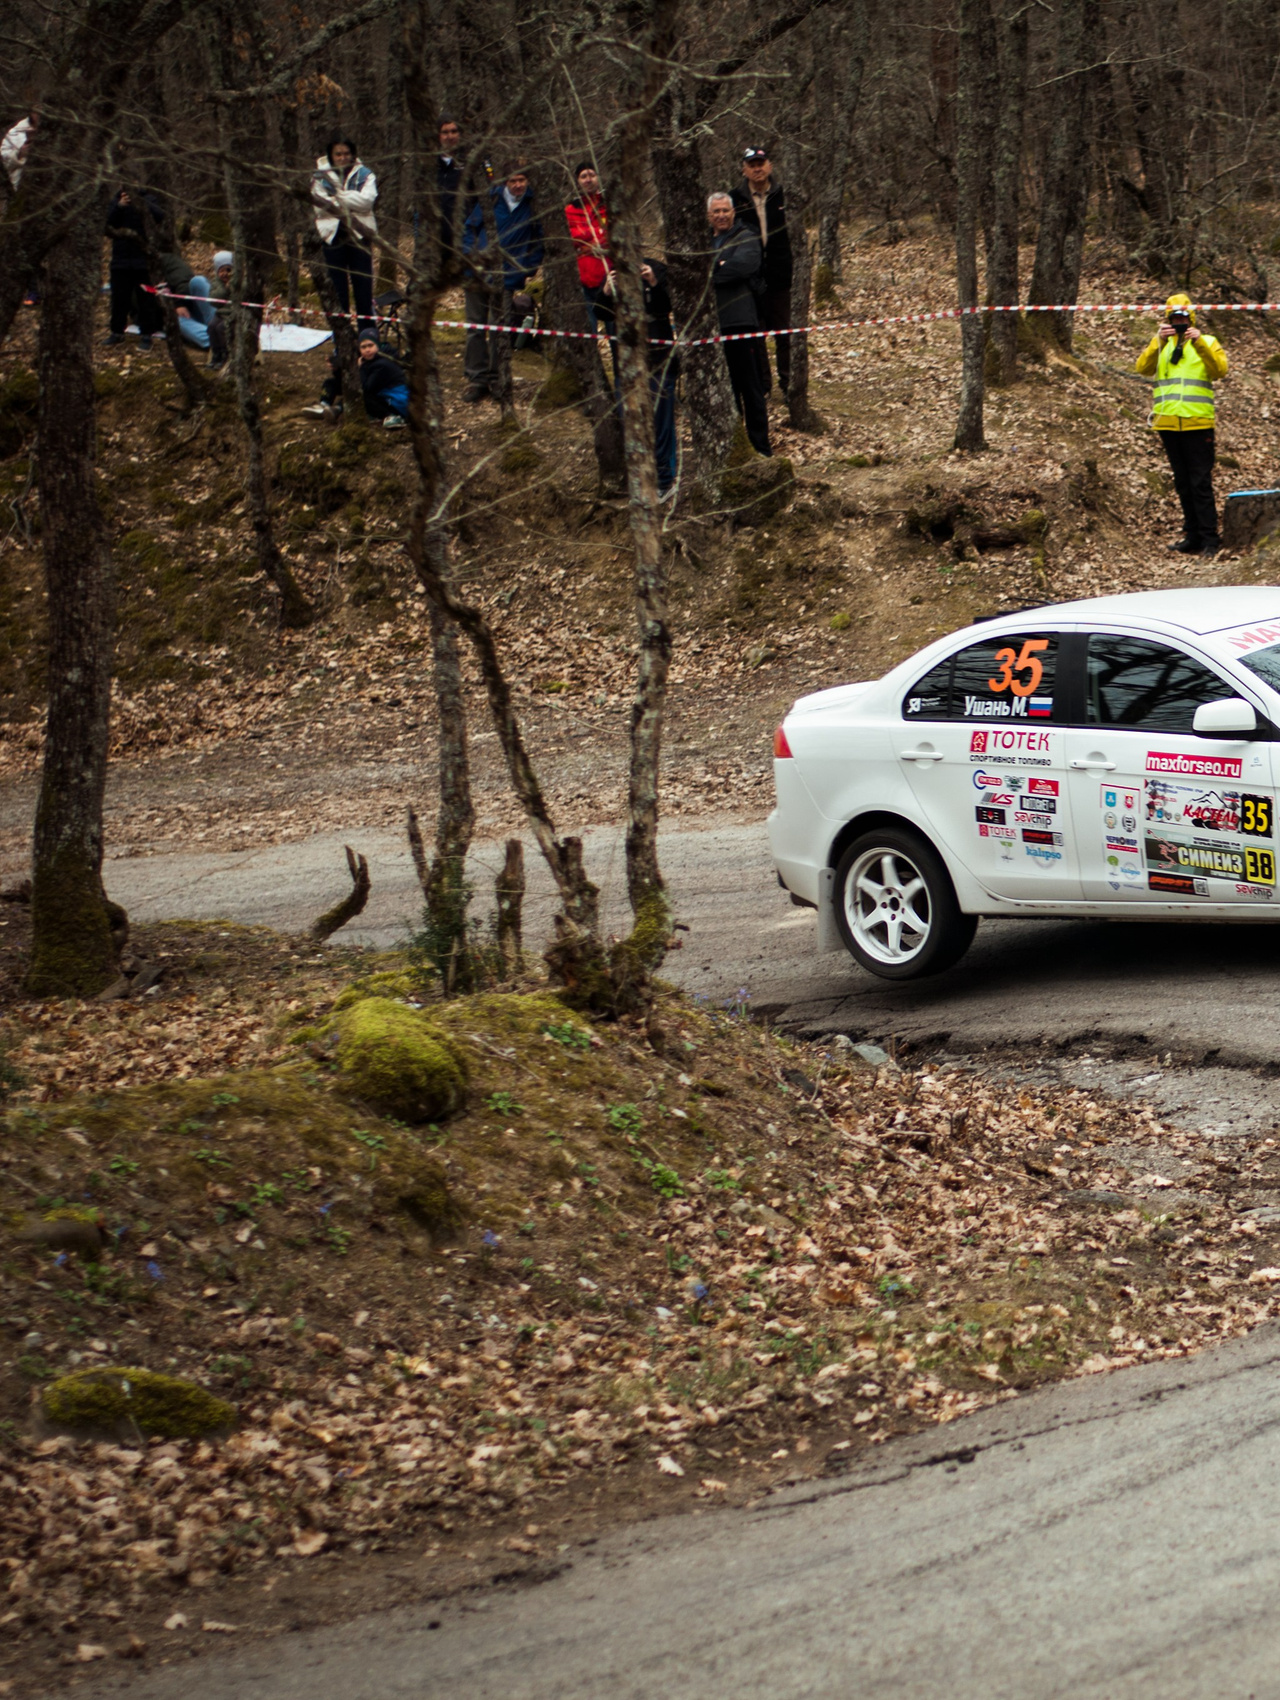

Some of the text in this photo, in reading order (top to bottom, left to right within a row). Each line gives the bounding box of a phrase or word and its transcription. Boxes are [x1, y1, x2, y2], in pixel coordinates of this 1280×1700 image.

[988, 639, 1049, 697] 35
[964, 696, 1010, 716] Ушань
[1011, 696, 1028, 717] М.
[1146, 755, 1240, 777] maxforseo.ru
[1243, 800, 1268, 832] 35
[1025, 846, 1062, 860] kalipso
[1177, 846, 1243, 873] СИМЕИЗ
[1247, 850, 1273, 880] 38
